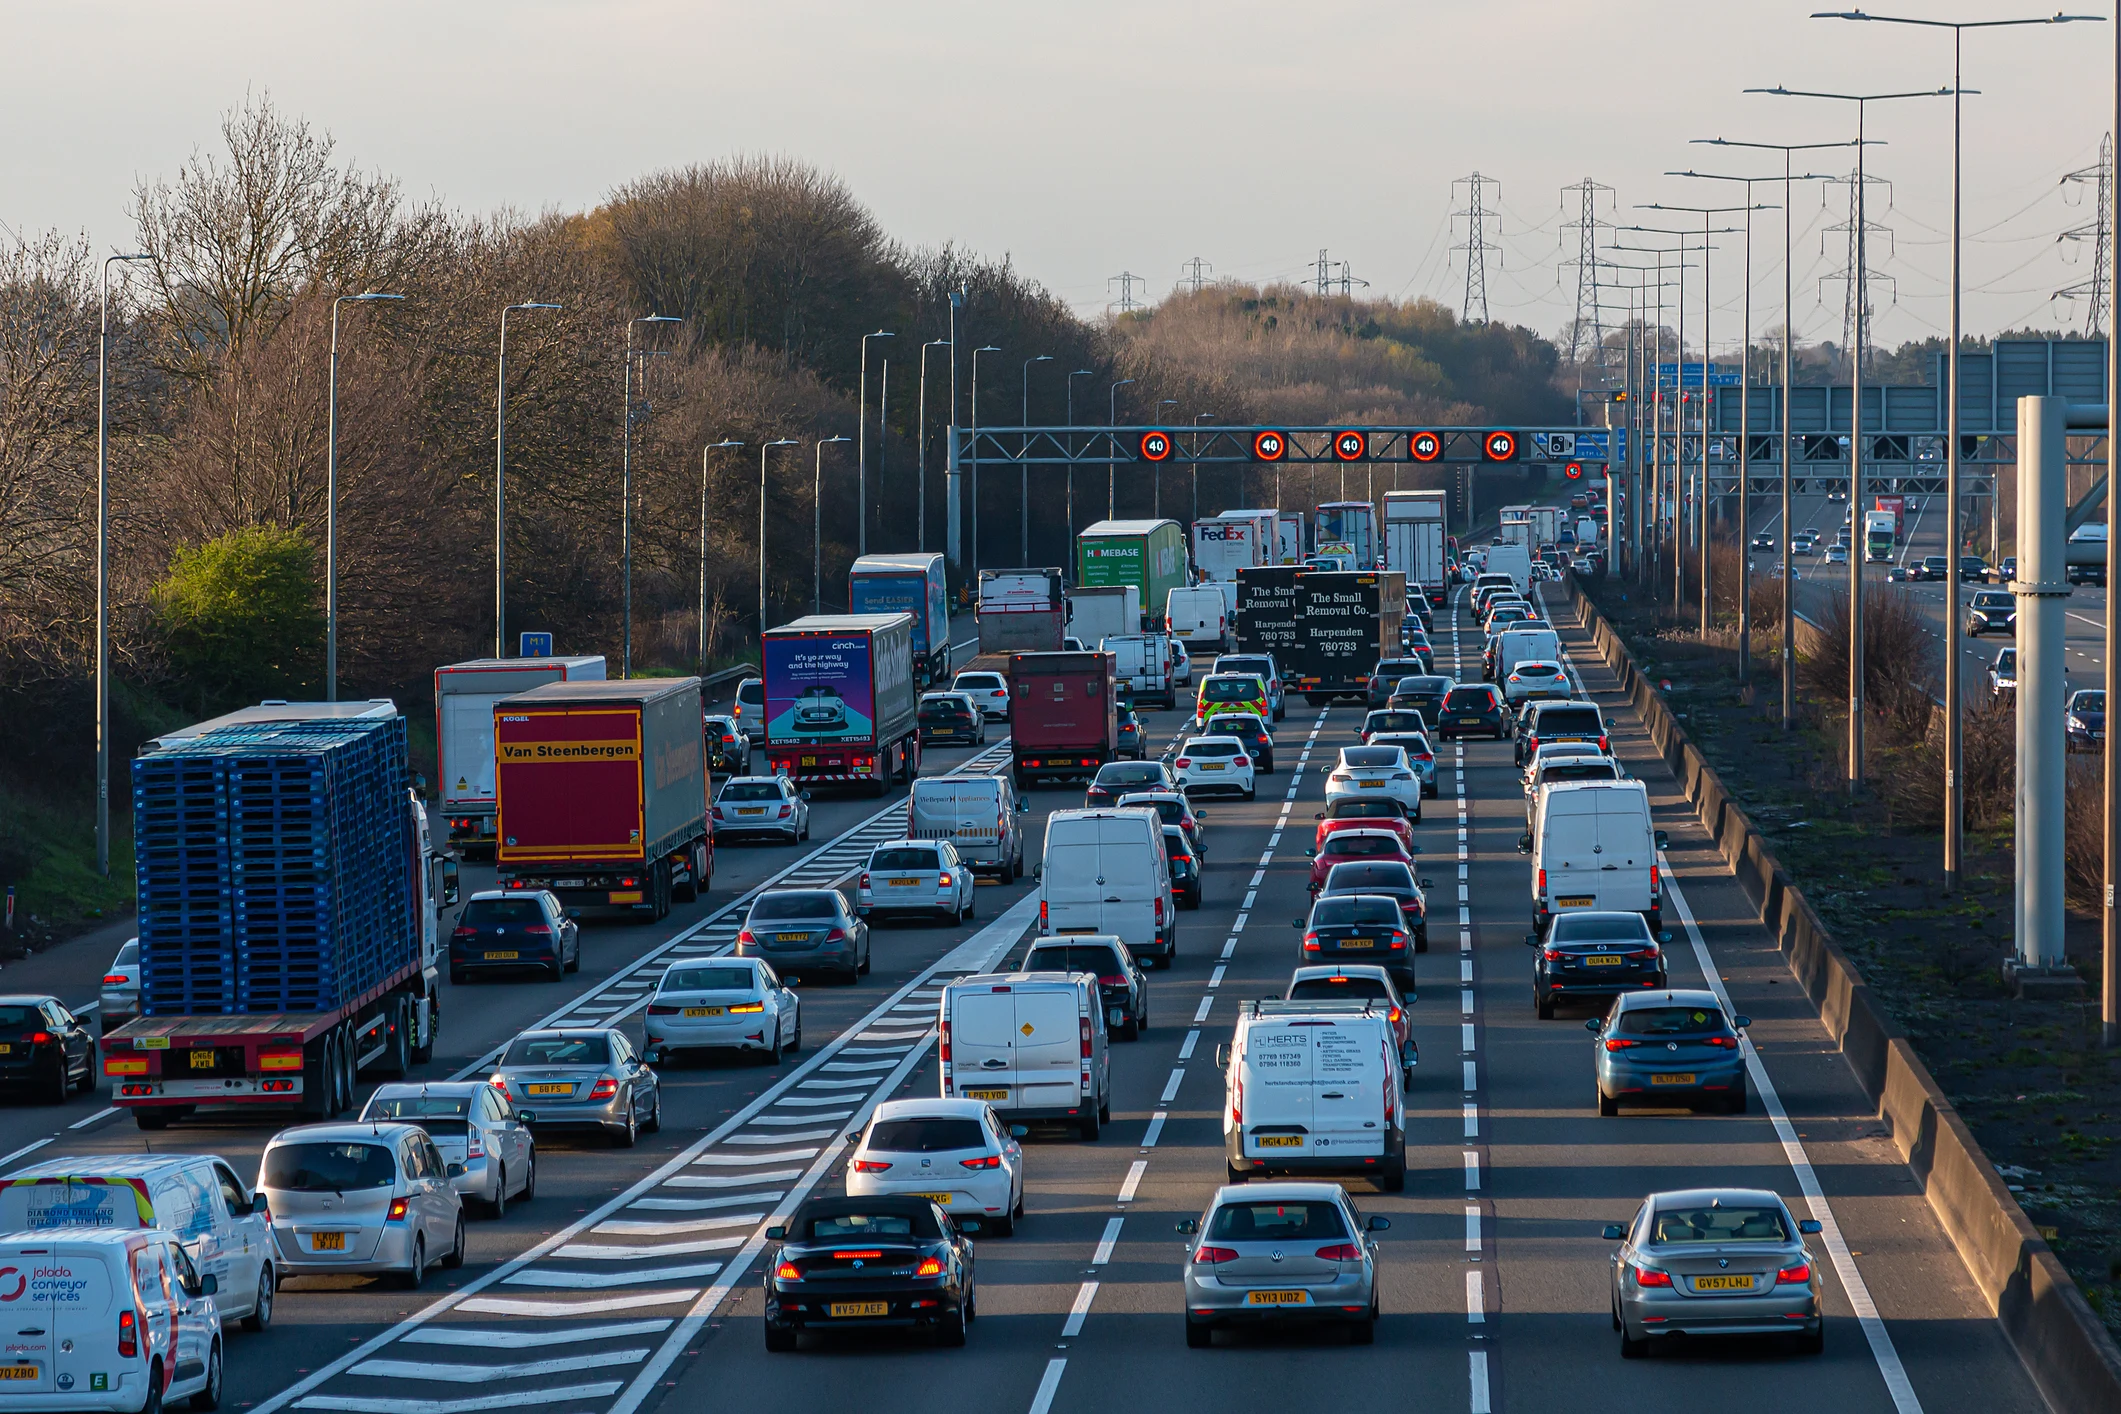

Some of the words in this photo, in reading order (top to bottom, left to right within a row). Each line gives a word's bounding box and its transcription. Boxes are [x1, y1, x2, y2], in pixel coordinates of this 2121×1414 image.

[1149, 440, 1164, 452] 40
[1262, 439, 1278, 452] 40
[1342, 440, 1358, 451] 40
[1418, 440, 1434, 452] 40
[1493, 440, 1509, 452] 40
[1201, 526, 1245, 541] FedEx
[1252, 587, 1271, 596] The
[1274, 586, 1295, 596] Sma
[864, 595, 884, 605] Send
[886, 596, 914, 604] EASIER
[1311, 593, 1331, 603] The
[1333, 592, 1362, 603] Small
[1245, 599, 1289, 608] Removal
[1306, 605, 1351, 616] Removal
[1353, 605, 1369, 615] Co.
[1255, 620, 1296, 629] Harpende
[1310, 628, 1364, 637] Harpenden
[529, 637, 544, 646] M1
[1319, 641, 1357, 651] 760783
[825, 653, 842, 662] way
[817, 660, 849, 670] highway
[503, 746, 532, 757] Van
[537, 745, 634, 757] Steenbergen
[687, 1009, 706, 1017] LK70
[707, 1008, 721, 1016] VCM
[1267, 1034, 1307, 1044] HERTS
[968, 1091, 989, 1099] LP67
[1262, 1137, 1280, 1146] HG14
[1283, 1136, 1300, 1146] JYS
[27, 1209, 69, 1217] DIAMOND
[71, 1208, 114, 1216] DRILLING
[26, 1218, 72, 1227] (HITCHIN)
[316, 1232, 340, 1241] LK09
[320, 1241, 339, 1249] RJJ
[32, 1266, 72, 1281] joloda
[31, 1280, 88, 1294] conveyor
[1699, 1278, 1726, 1288] GV57
[1728, 1277, 1749, 1287] LHJ
[32, 1292, 80, 1301] services
[1255, 1292, 1277, 1303] SY13
[835, 1304, 861, 1315] WV57
[864, 1303, 883, 1313] AEF
[94, 1375, 103, 1386] E
